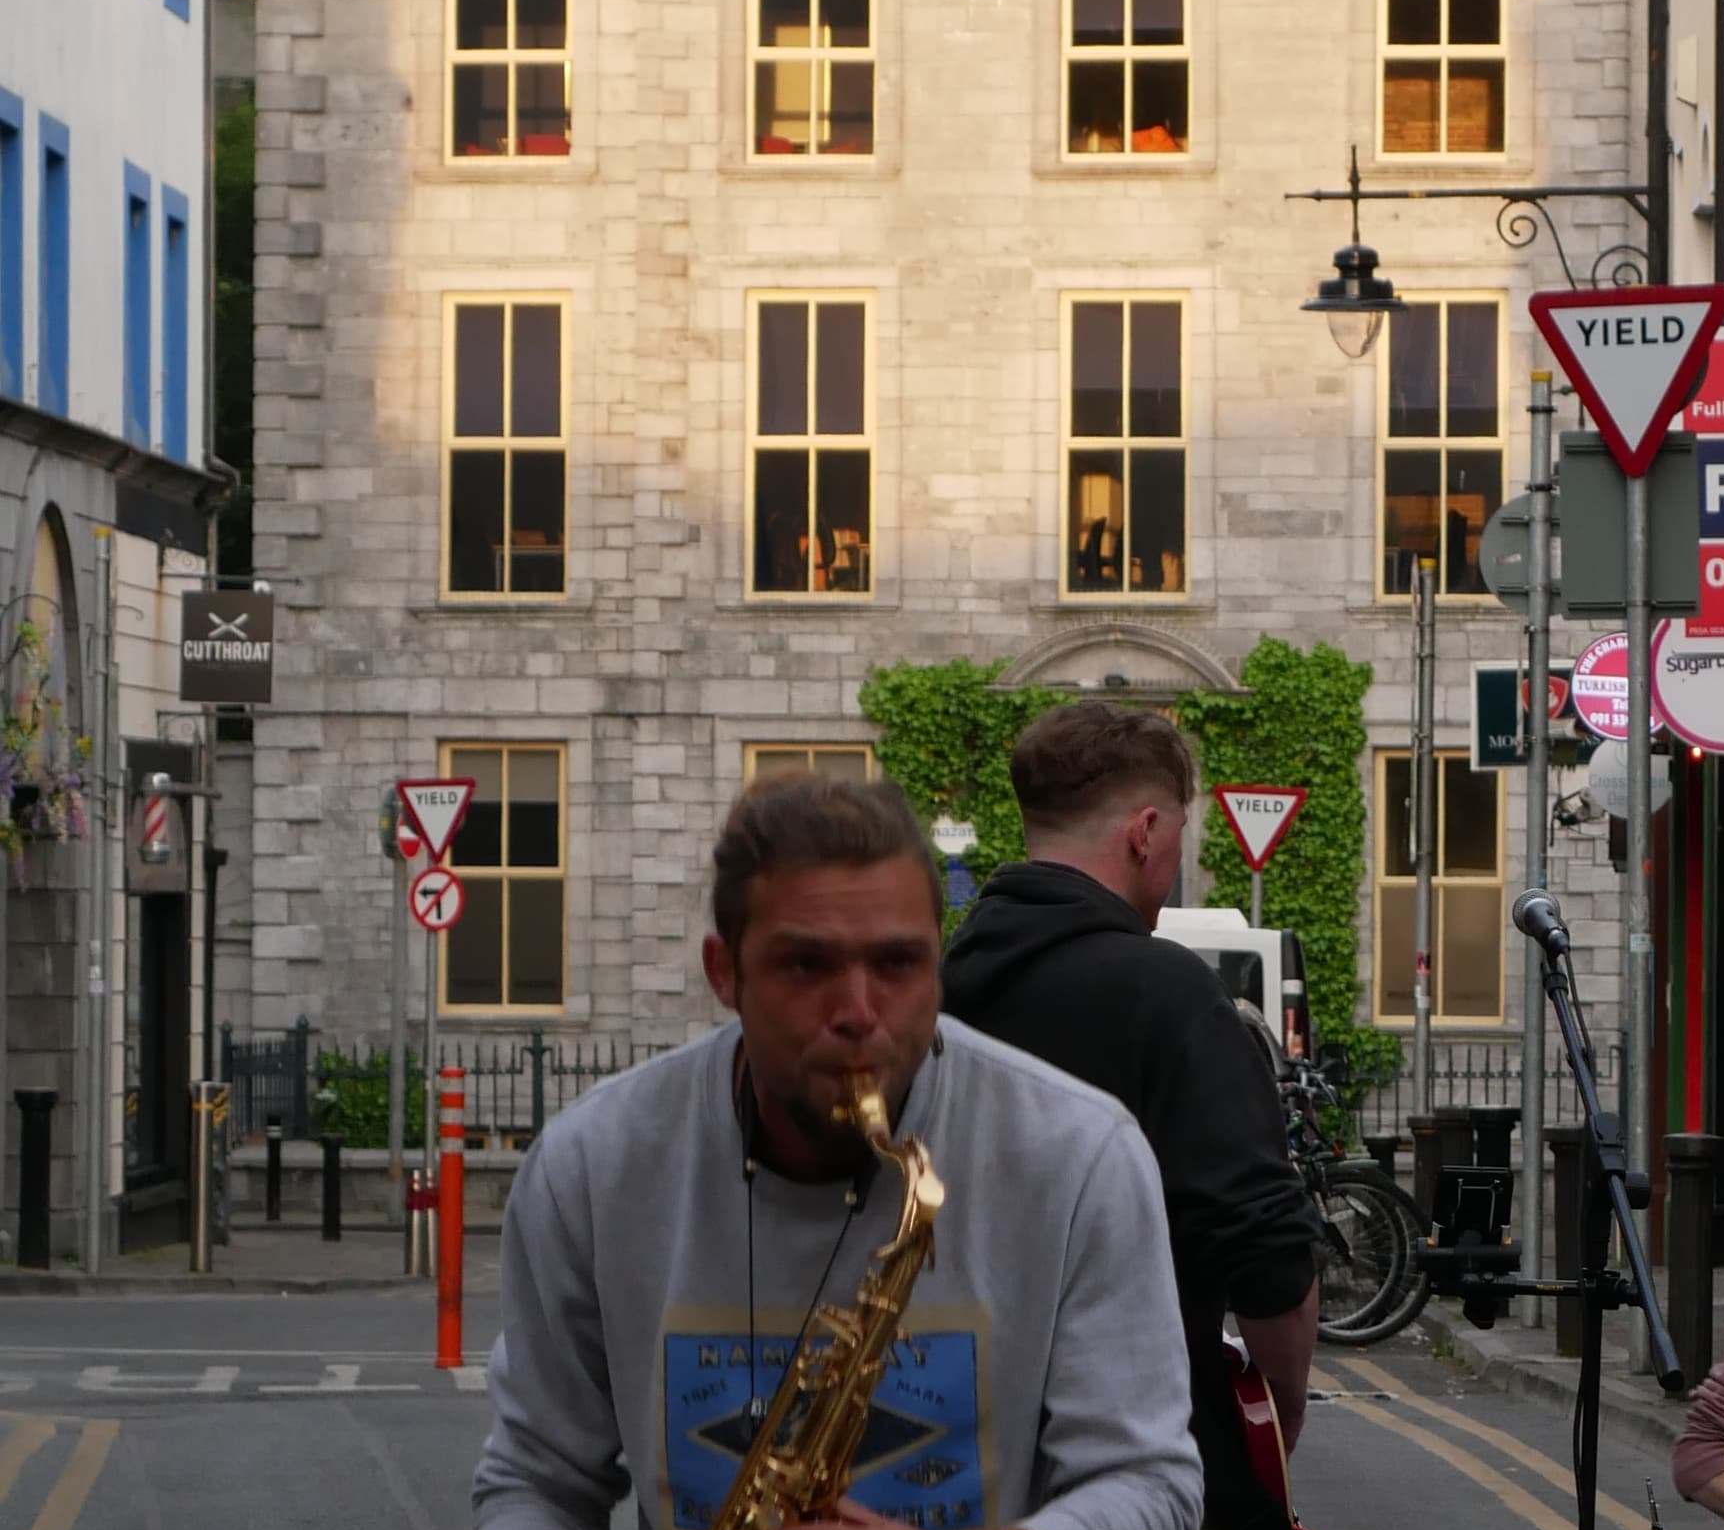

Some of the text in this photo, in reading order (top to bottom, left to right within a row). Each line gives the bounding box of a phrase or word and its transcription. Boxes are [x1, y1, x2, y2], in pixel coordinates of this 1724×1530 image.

[1576, 316, 1684, 347] YIELD
[183, 639, 271, 663] CUTTHROAT
[1577, 679, 1626, 691] TURKISH
[415, 790, 458, 807] YIELD
[1235, 797, 1285, 814] YIELD
